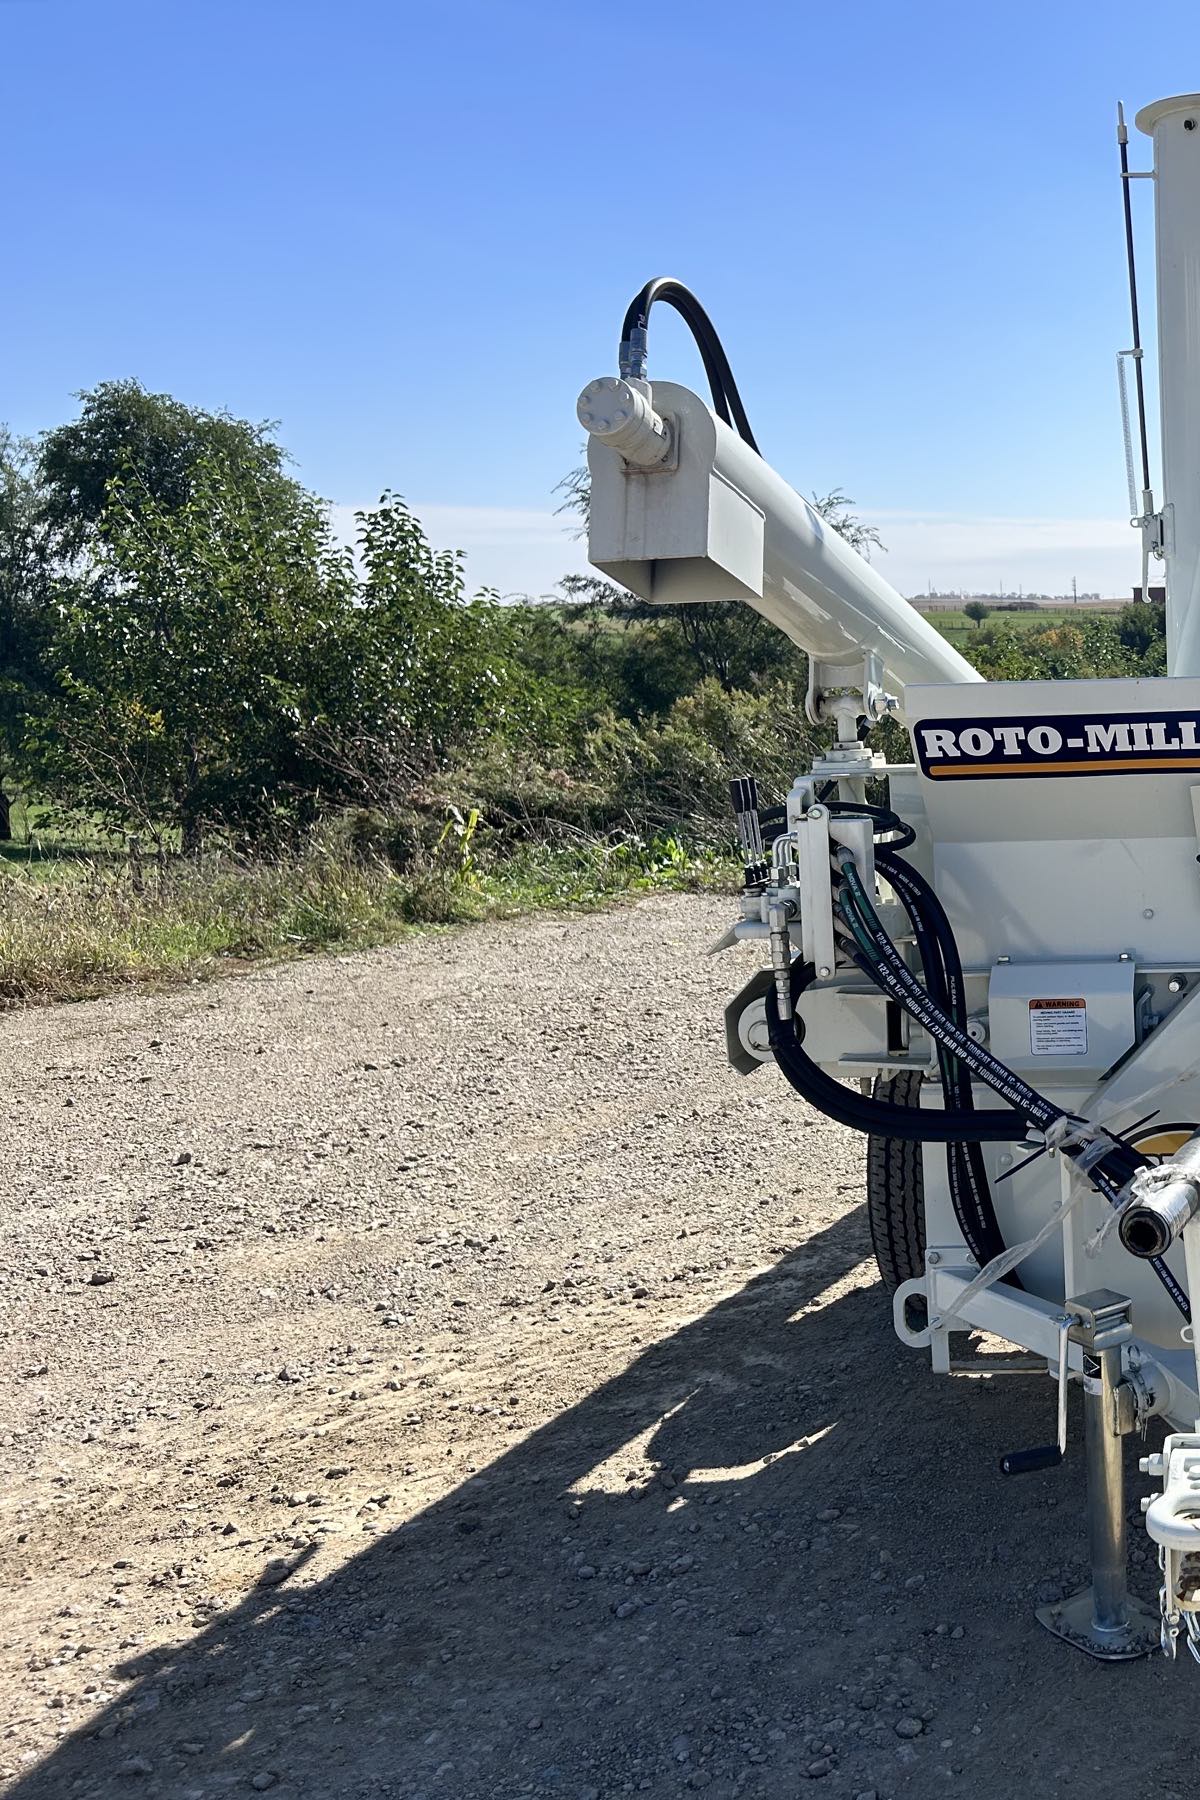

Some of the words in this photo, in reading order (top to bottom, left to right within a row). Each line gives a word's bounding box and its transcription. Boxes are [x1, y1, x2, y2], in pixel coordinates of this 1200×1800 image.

[877, 962, 897, 986] 122-08
[905, 997, 922, 1015] 4000
[918, 1011, 931, 1025] PSI
[931, 1025, 946, 1039] 275
[942, 1035, 957, 1050] BAR
[954, 1046, 968, 1059] WP
[965, 1055, 979, 1069] SAE
[976, 1065, 1004, 1089] 100R2AT
[1001, 1085, 1022, 1103] MSHA
[911, 983, 922, 996] PSI
[922, 998, 935, 1012] 275
[932, 1009, 946, 1024] BAR
[953, 1031, 967, 1044] SAE
